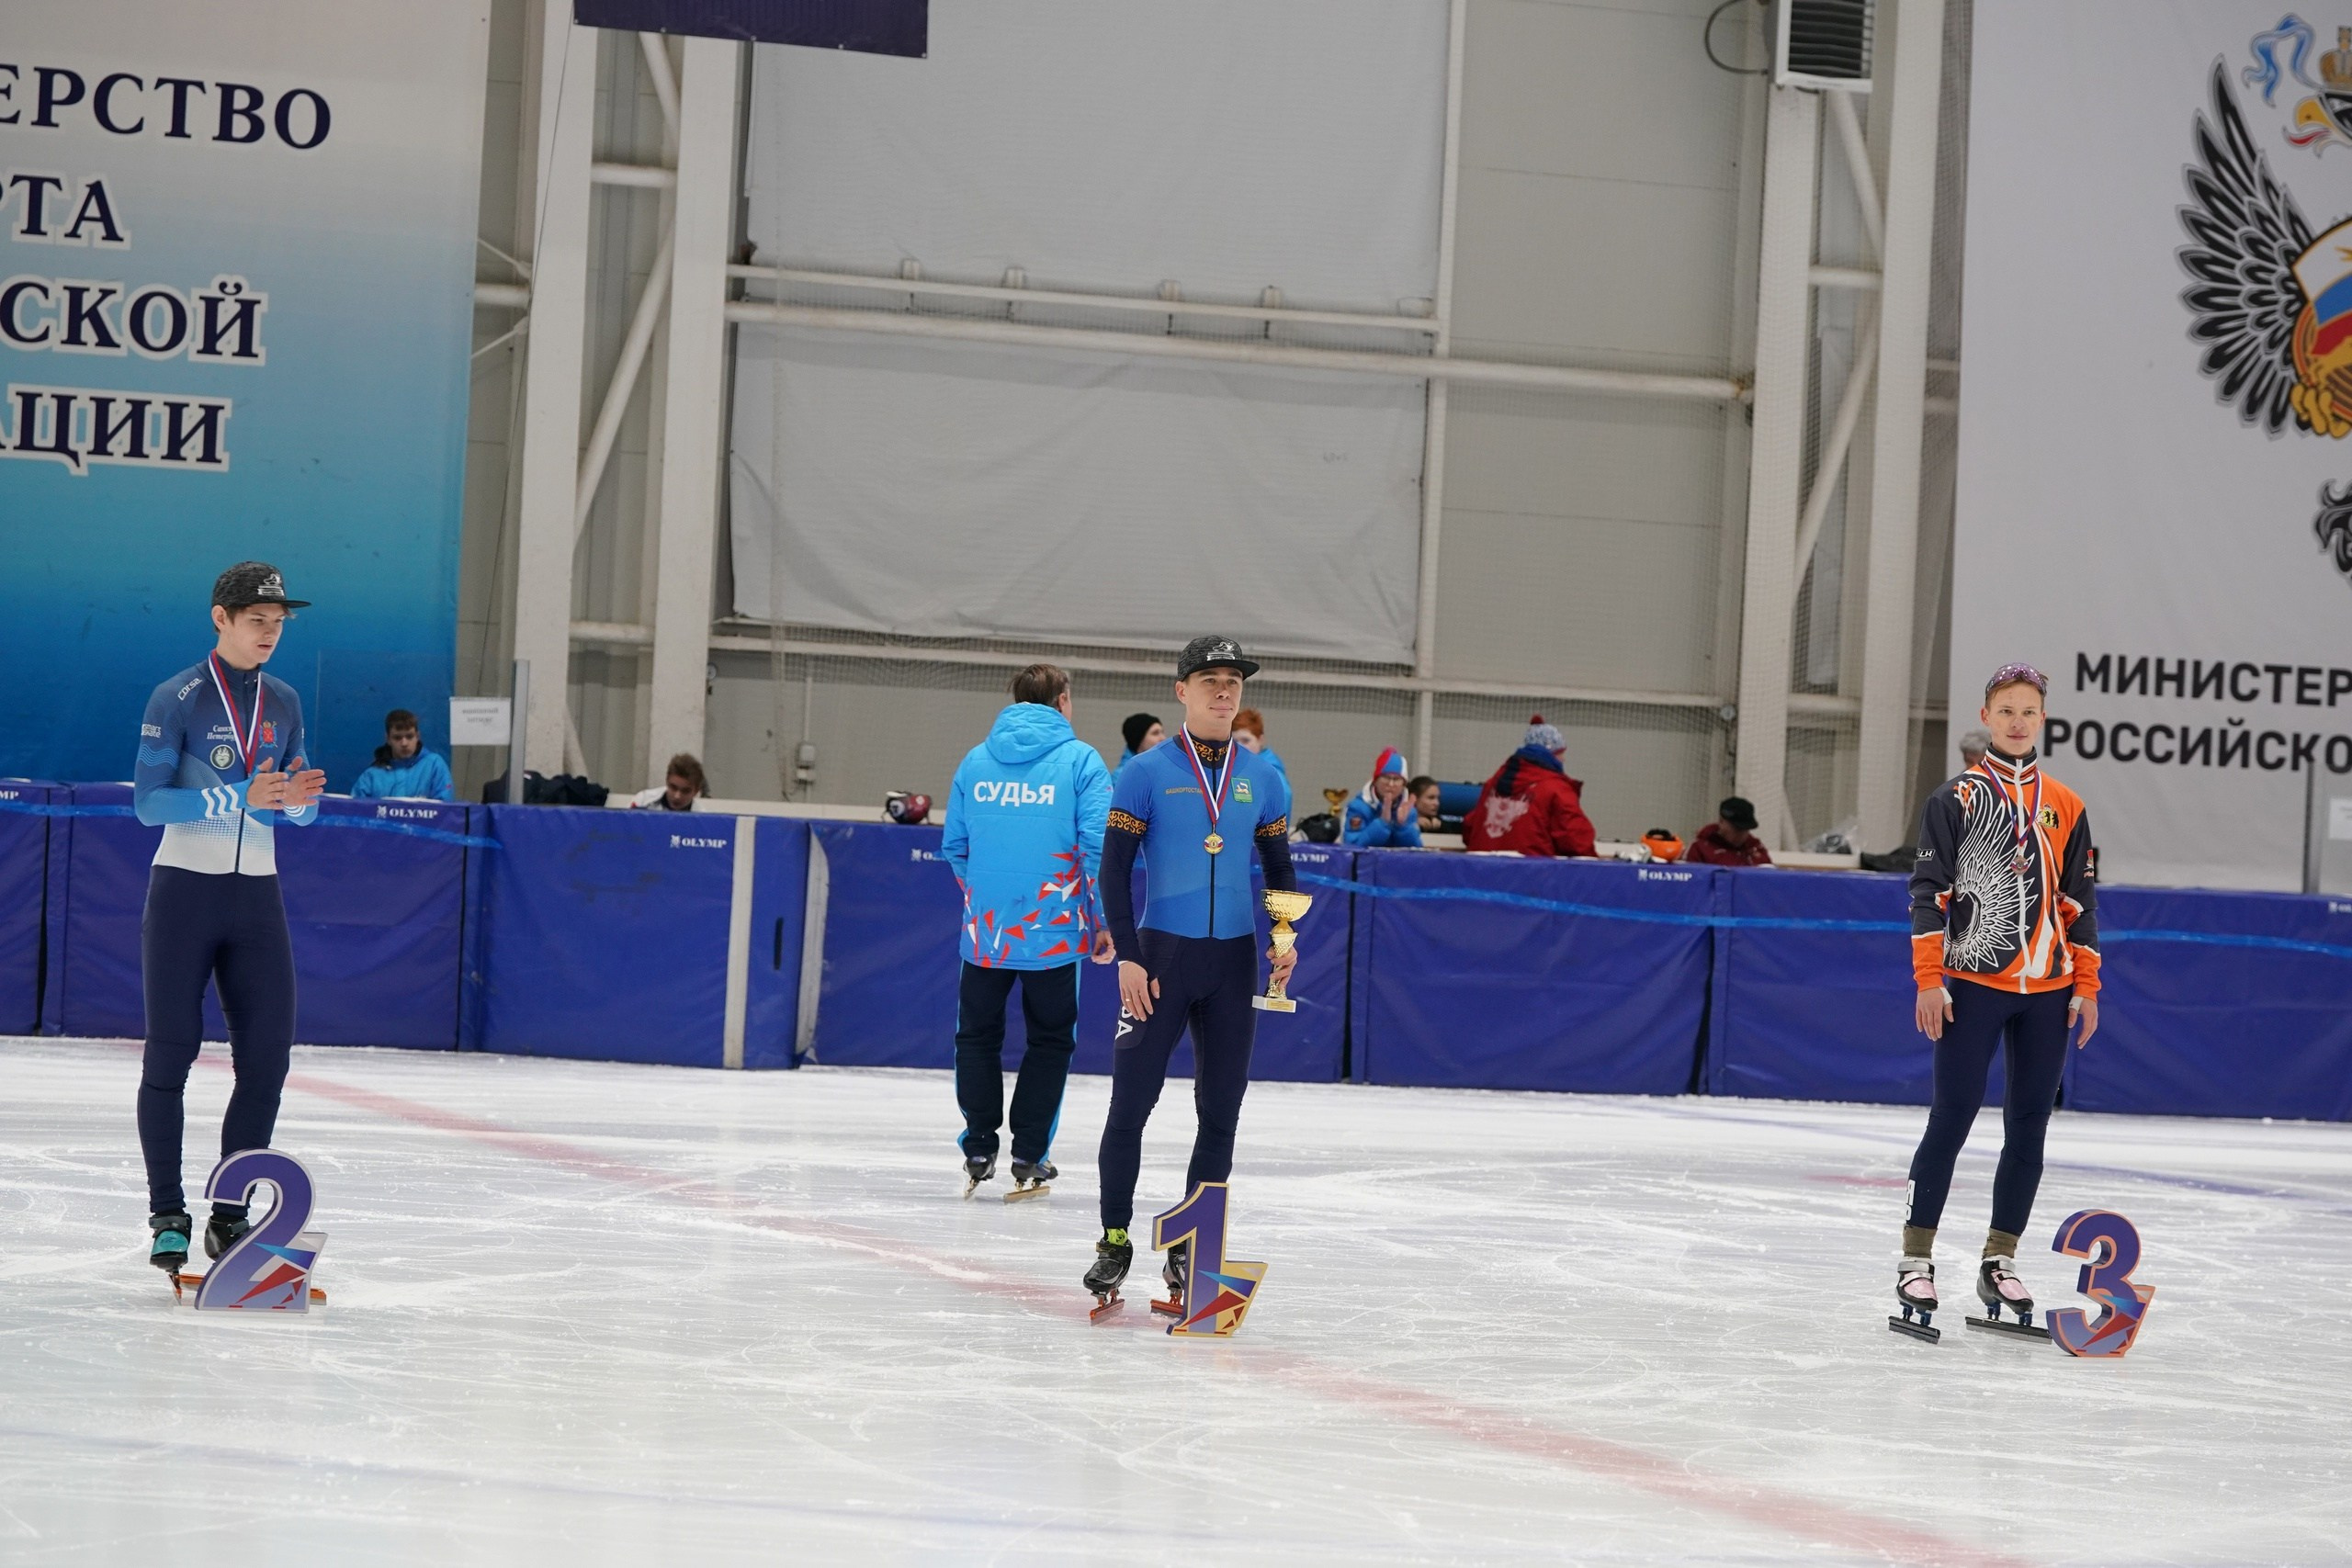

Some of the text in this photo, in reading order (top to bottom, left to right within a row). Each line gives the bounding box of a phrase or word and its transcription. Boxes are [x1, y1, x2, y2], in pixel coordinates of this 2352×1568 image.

[0, 175, 125, 243] ТА
[0, 280, 262, 358] СКОЙ
[0, 391, 226, 468] ЦИИ
[2075, 651, 2352, 707] МИНИСТЕР
[2042, 717, 2352, 775] РОССИЙСКО
[389, 807, 438, 818] OLYMP
[973, 781, 1056, 807] СУДЬЯ
[681, 837, 728, 848] OLYMP
[1290, 852, 1330, 863] LYMP
[1648, 871, 1693, 882] OLYMP
[195, 1148, 323, 1313] 2
[1151, 1181, 1262, 1337] 1
[2046, 1209, 2153, 1357] 3
